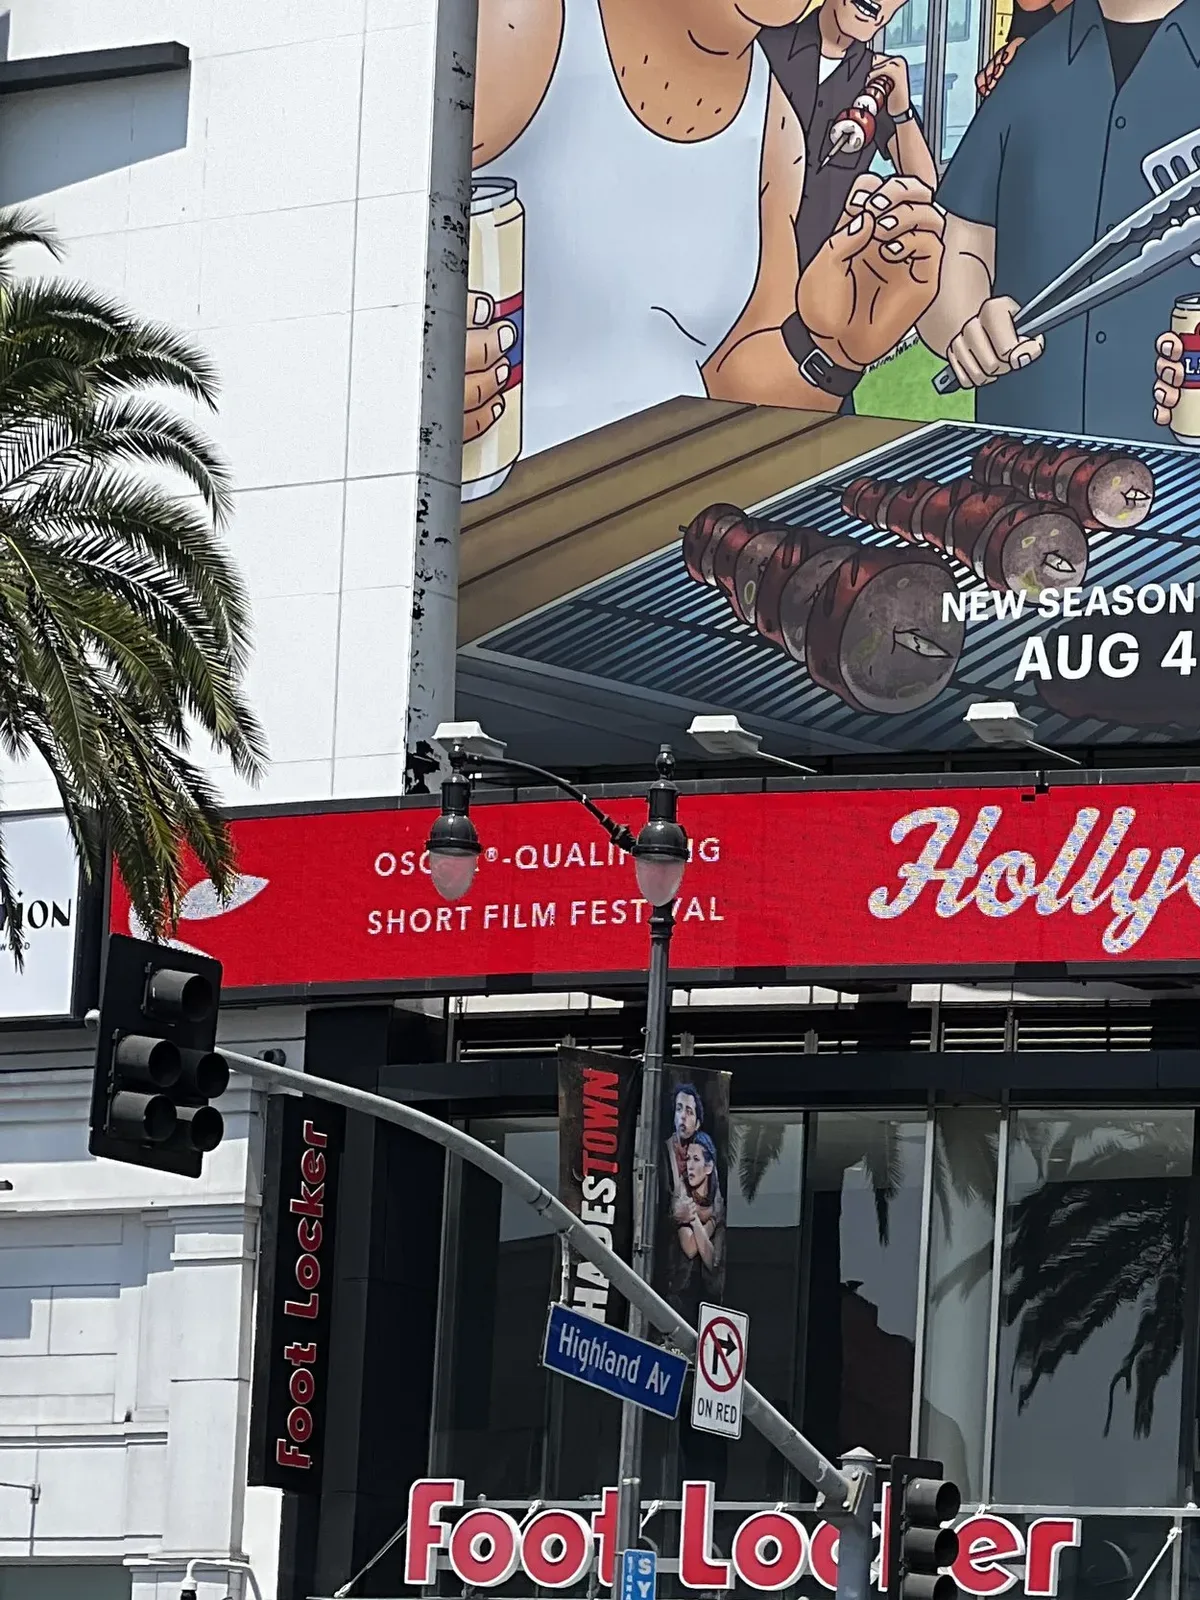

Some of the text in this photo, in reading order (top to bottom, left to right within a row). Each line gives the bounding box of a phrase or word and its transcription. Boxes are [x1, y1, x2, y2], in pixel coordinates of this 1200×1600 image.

[941, 582, 1195, 623] NEW SEASON
[1014, 630, 1197, 682] AUG 4
[367, 905, 472, 935] SHORT
[483, 902, 556, 930] FILM
[276, 1119, 328, 1470] Foot Locker
[558, 1322, 671, 1396] Highland Av
[697, 1397, 738, 1425] ON RED
